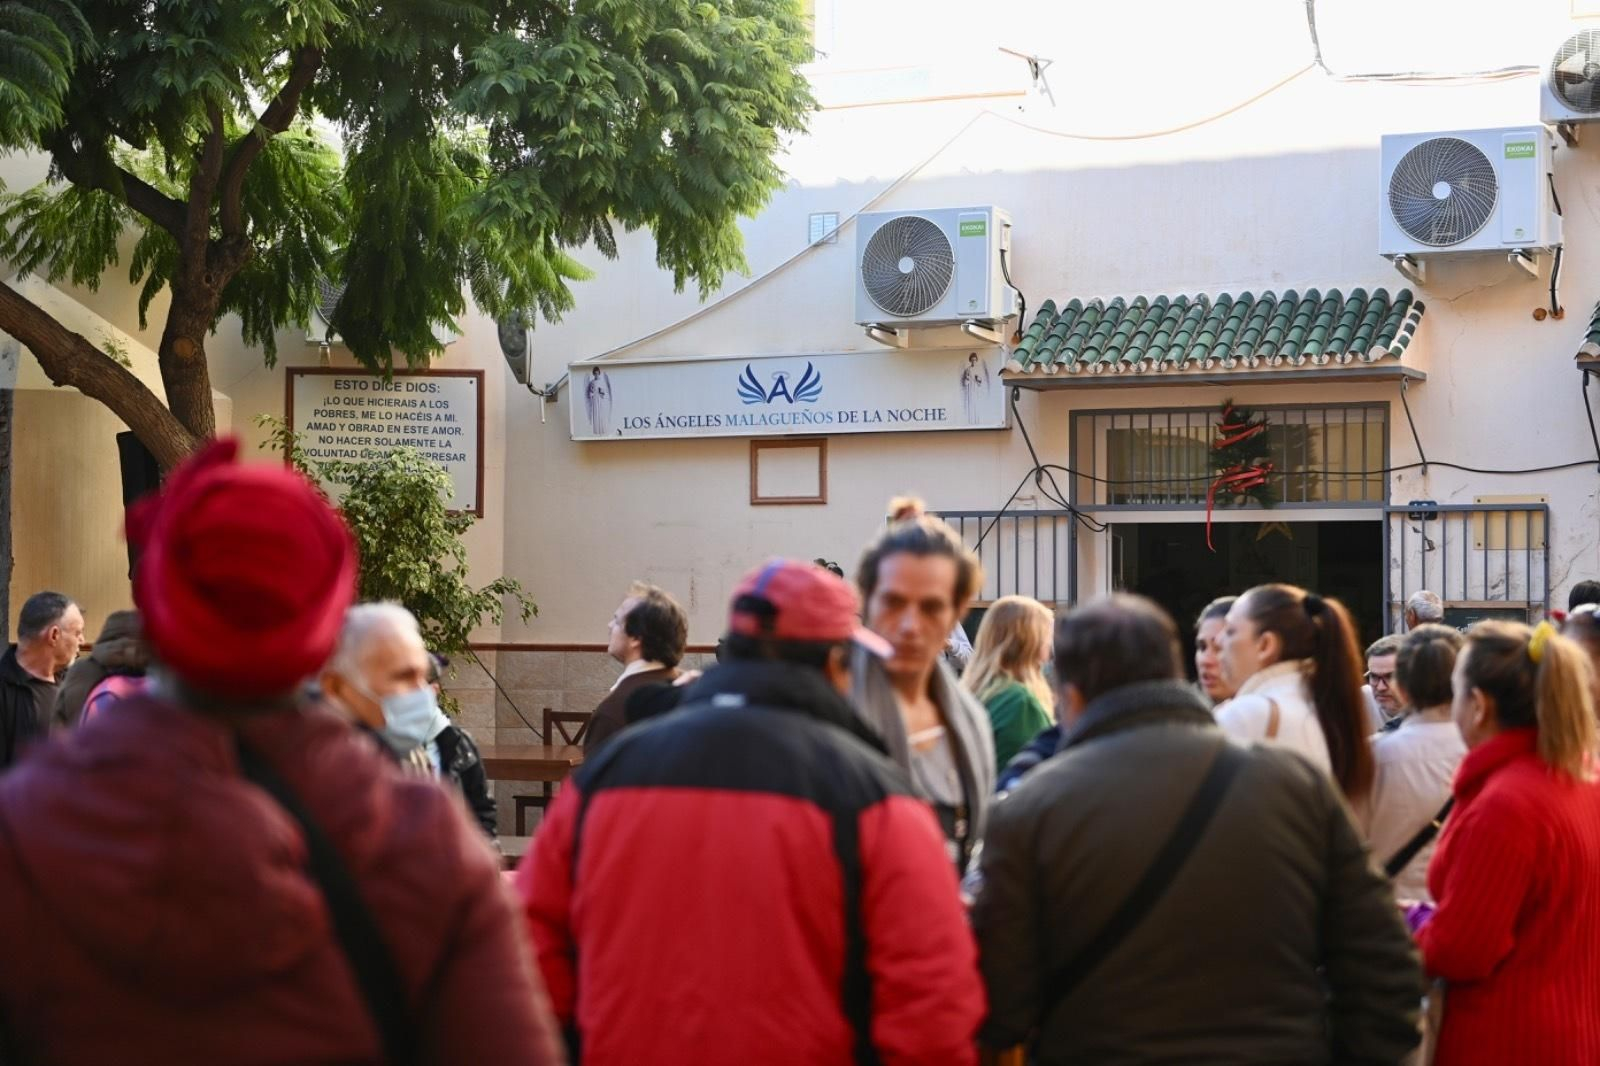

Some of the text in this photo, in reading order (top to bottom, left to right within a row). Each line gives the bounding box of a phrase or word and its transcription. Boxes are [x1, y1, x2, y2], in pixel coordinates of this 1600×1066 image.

[334, 379, 440, 393] ESTO DICE DIOS:
[766, 375, 794, 404] A
[323, 396, 449, 409] ¡LO QUE HICIERAIS A LOS
[361, 410, 376, 420] ME
[378, 411, 393, 420] LO
[395, 410, 433, 422] HACÉIS
[435, 413, 442, 422] A
[623, 408, 946, 430] LOS ÁNGELES MALAGUEÑOS DE LA NOCHE
[306, 422, 336, 432] AMAD
[338, 423, 346, 432] Y
[348, 423, 385, 433] OBRAD
[387, 424, 401, 434] EN
[403, 425, 429, 435] ESTE
[318, 435, 452, 448] NO HACER SOLAMENTE LA
[303, 448, 357, 459] VOLUNTAD
